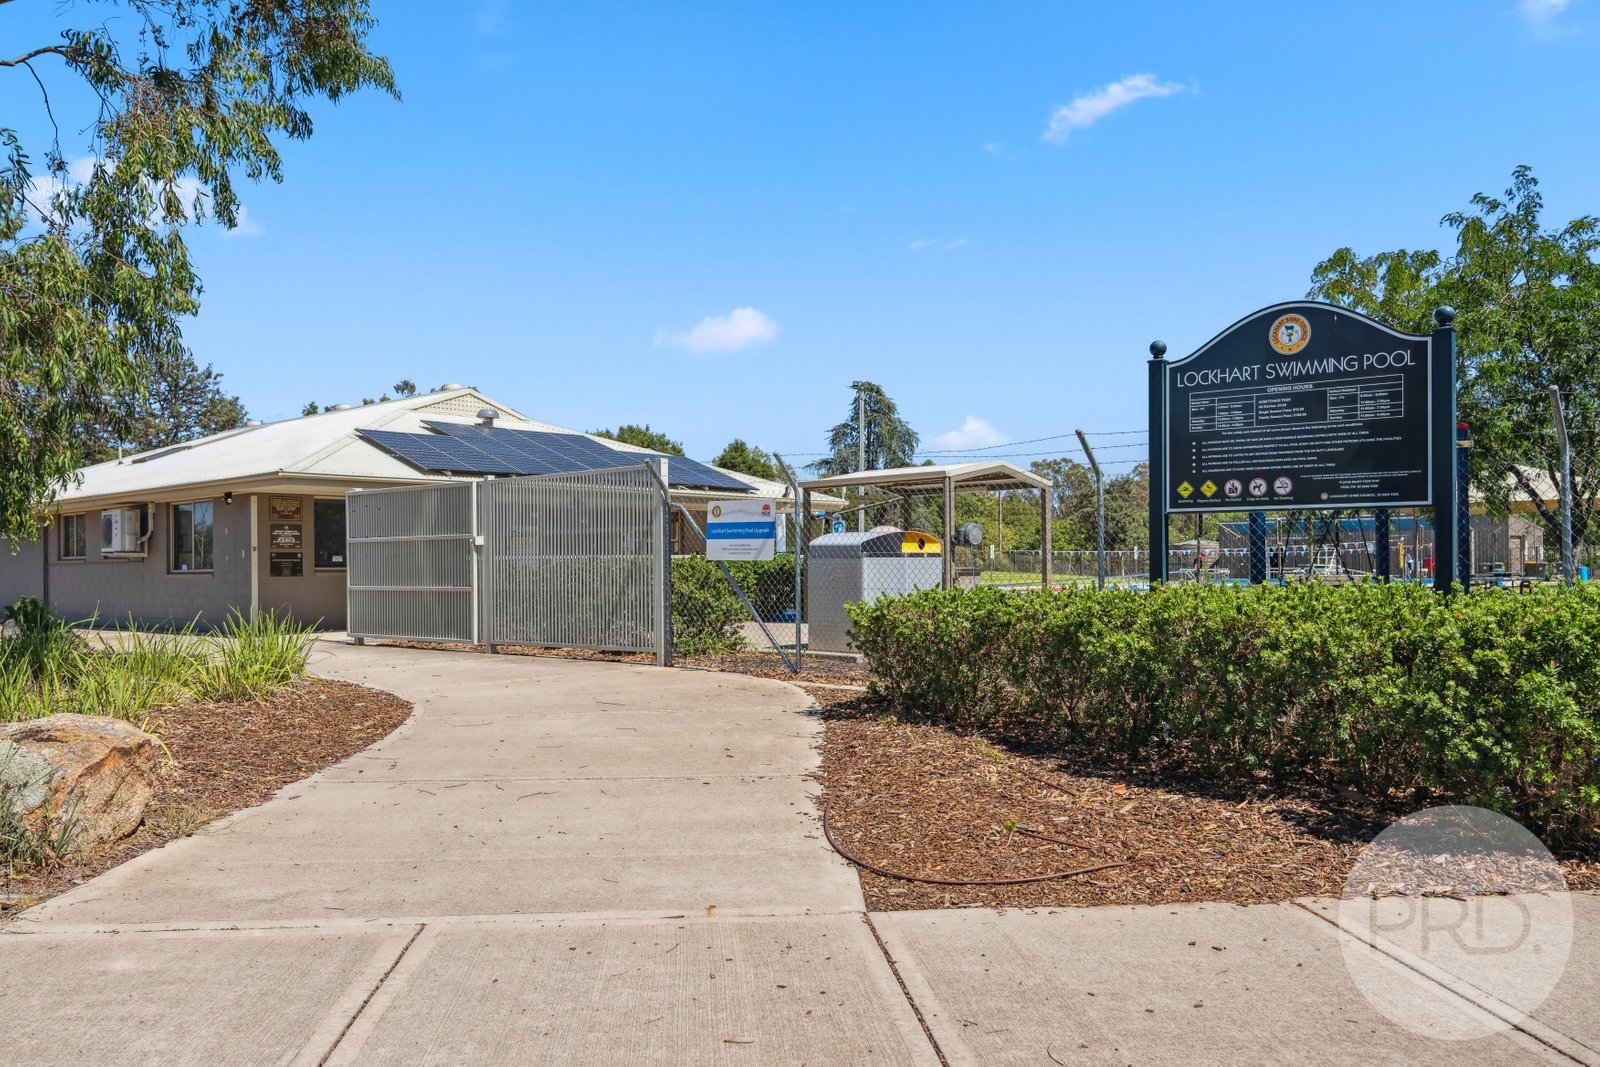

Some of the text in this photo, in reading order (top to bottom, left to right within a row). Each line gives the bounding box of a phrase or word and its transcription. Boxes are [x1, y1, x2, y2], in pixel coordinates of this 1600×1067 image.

[1177, 350, 1416, 388] LOCKHART SWIMMING POOL
